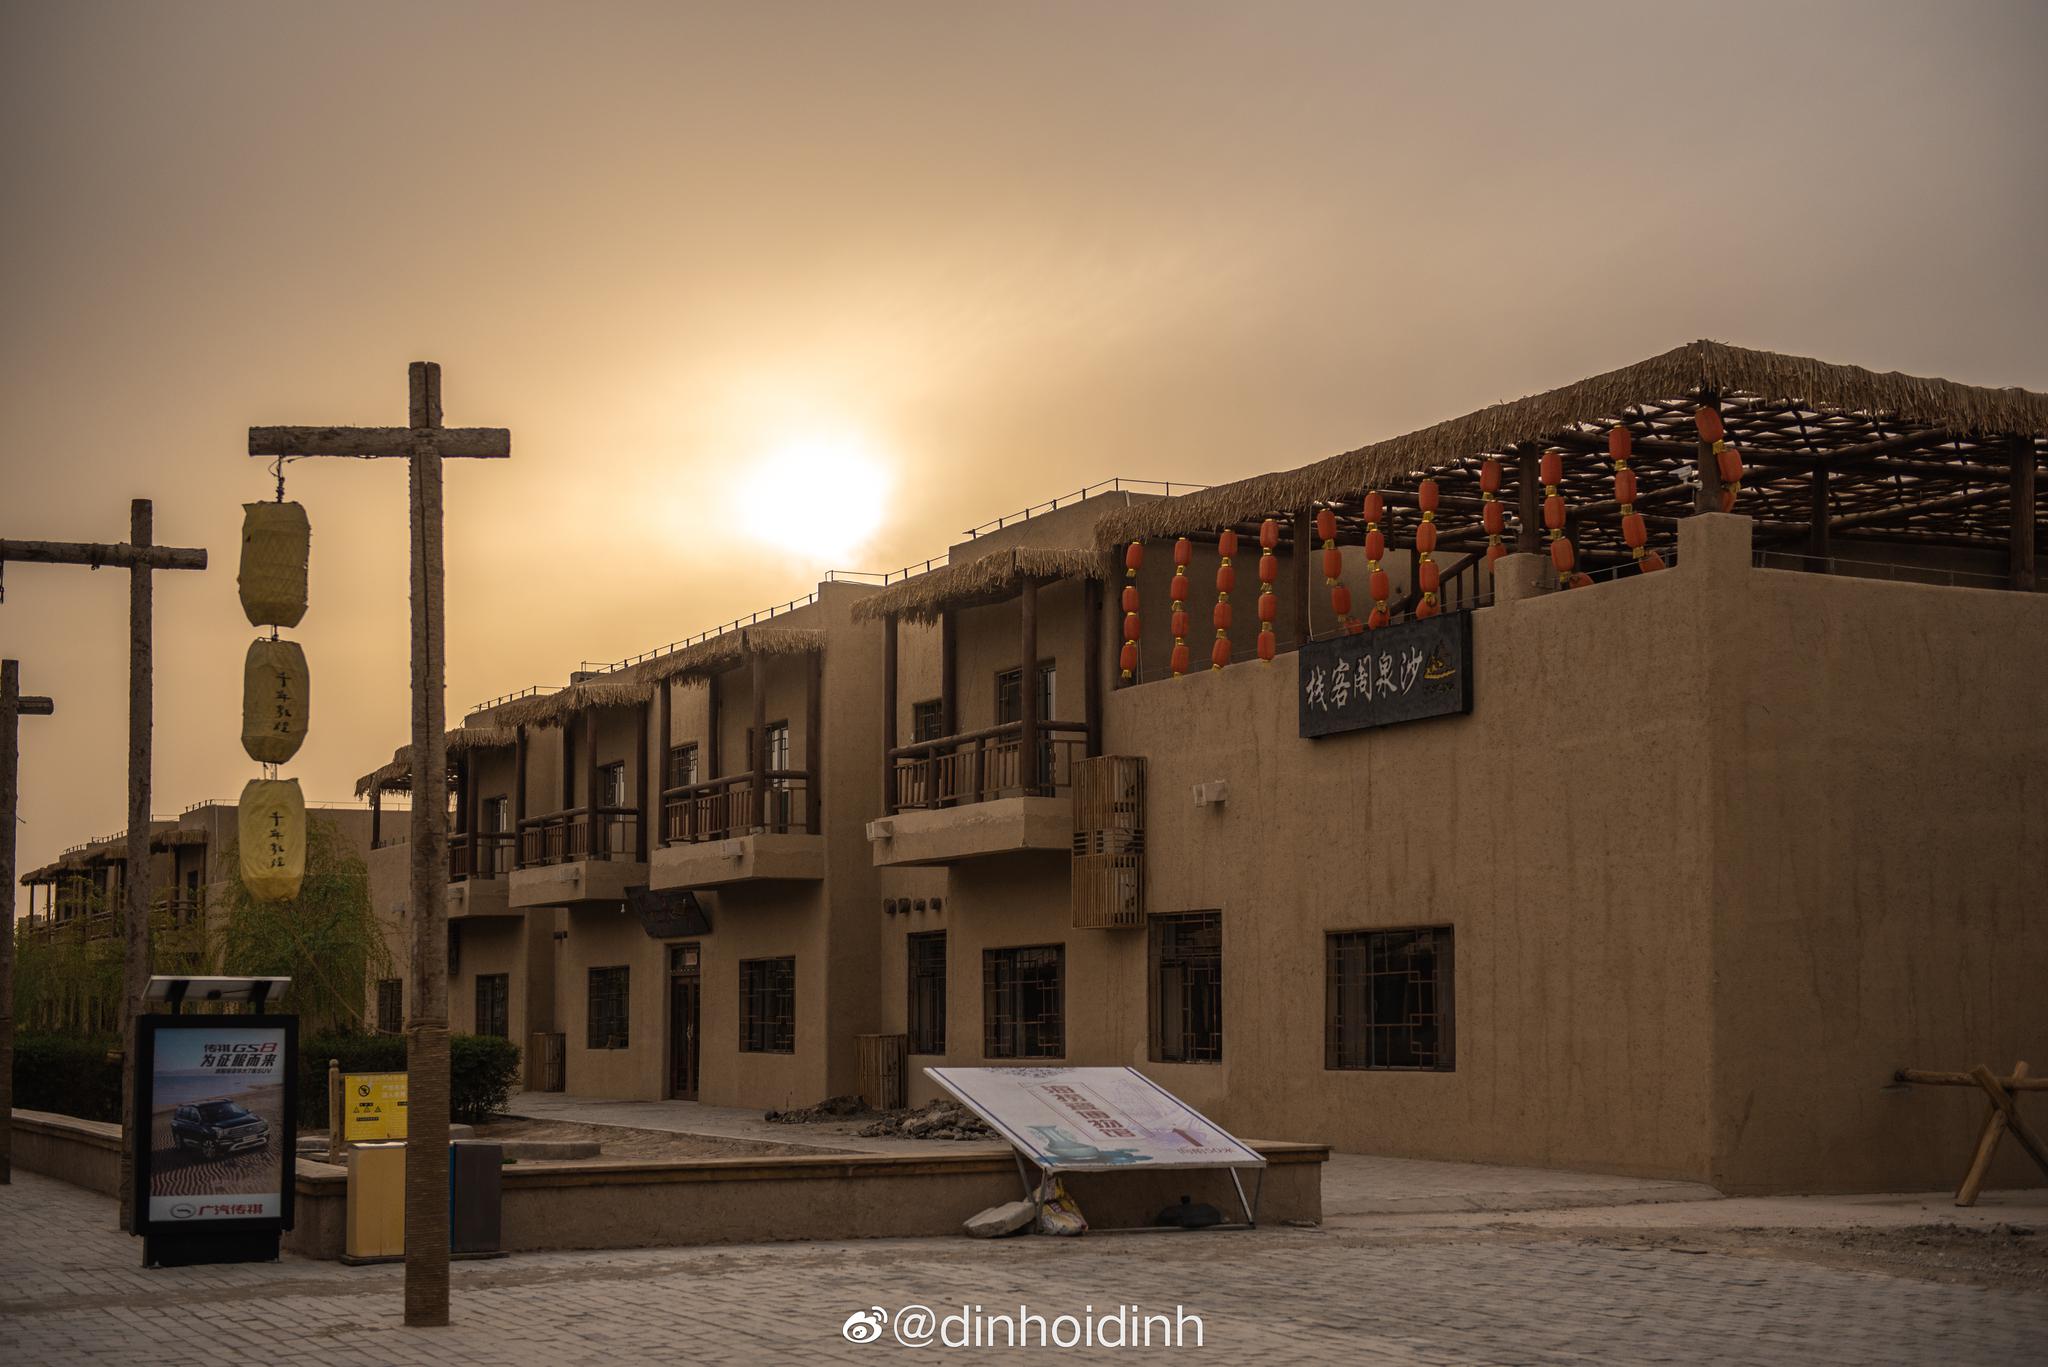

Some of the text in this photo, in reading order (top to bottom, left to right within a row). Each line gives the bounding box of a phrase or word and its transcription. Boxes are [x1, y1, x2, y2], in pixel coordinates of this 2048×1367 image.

[200, 1053, 277, 1067] 为征服而来
[198, 1203, 263, 1216] 广汽传祺
